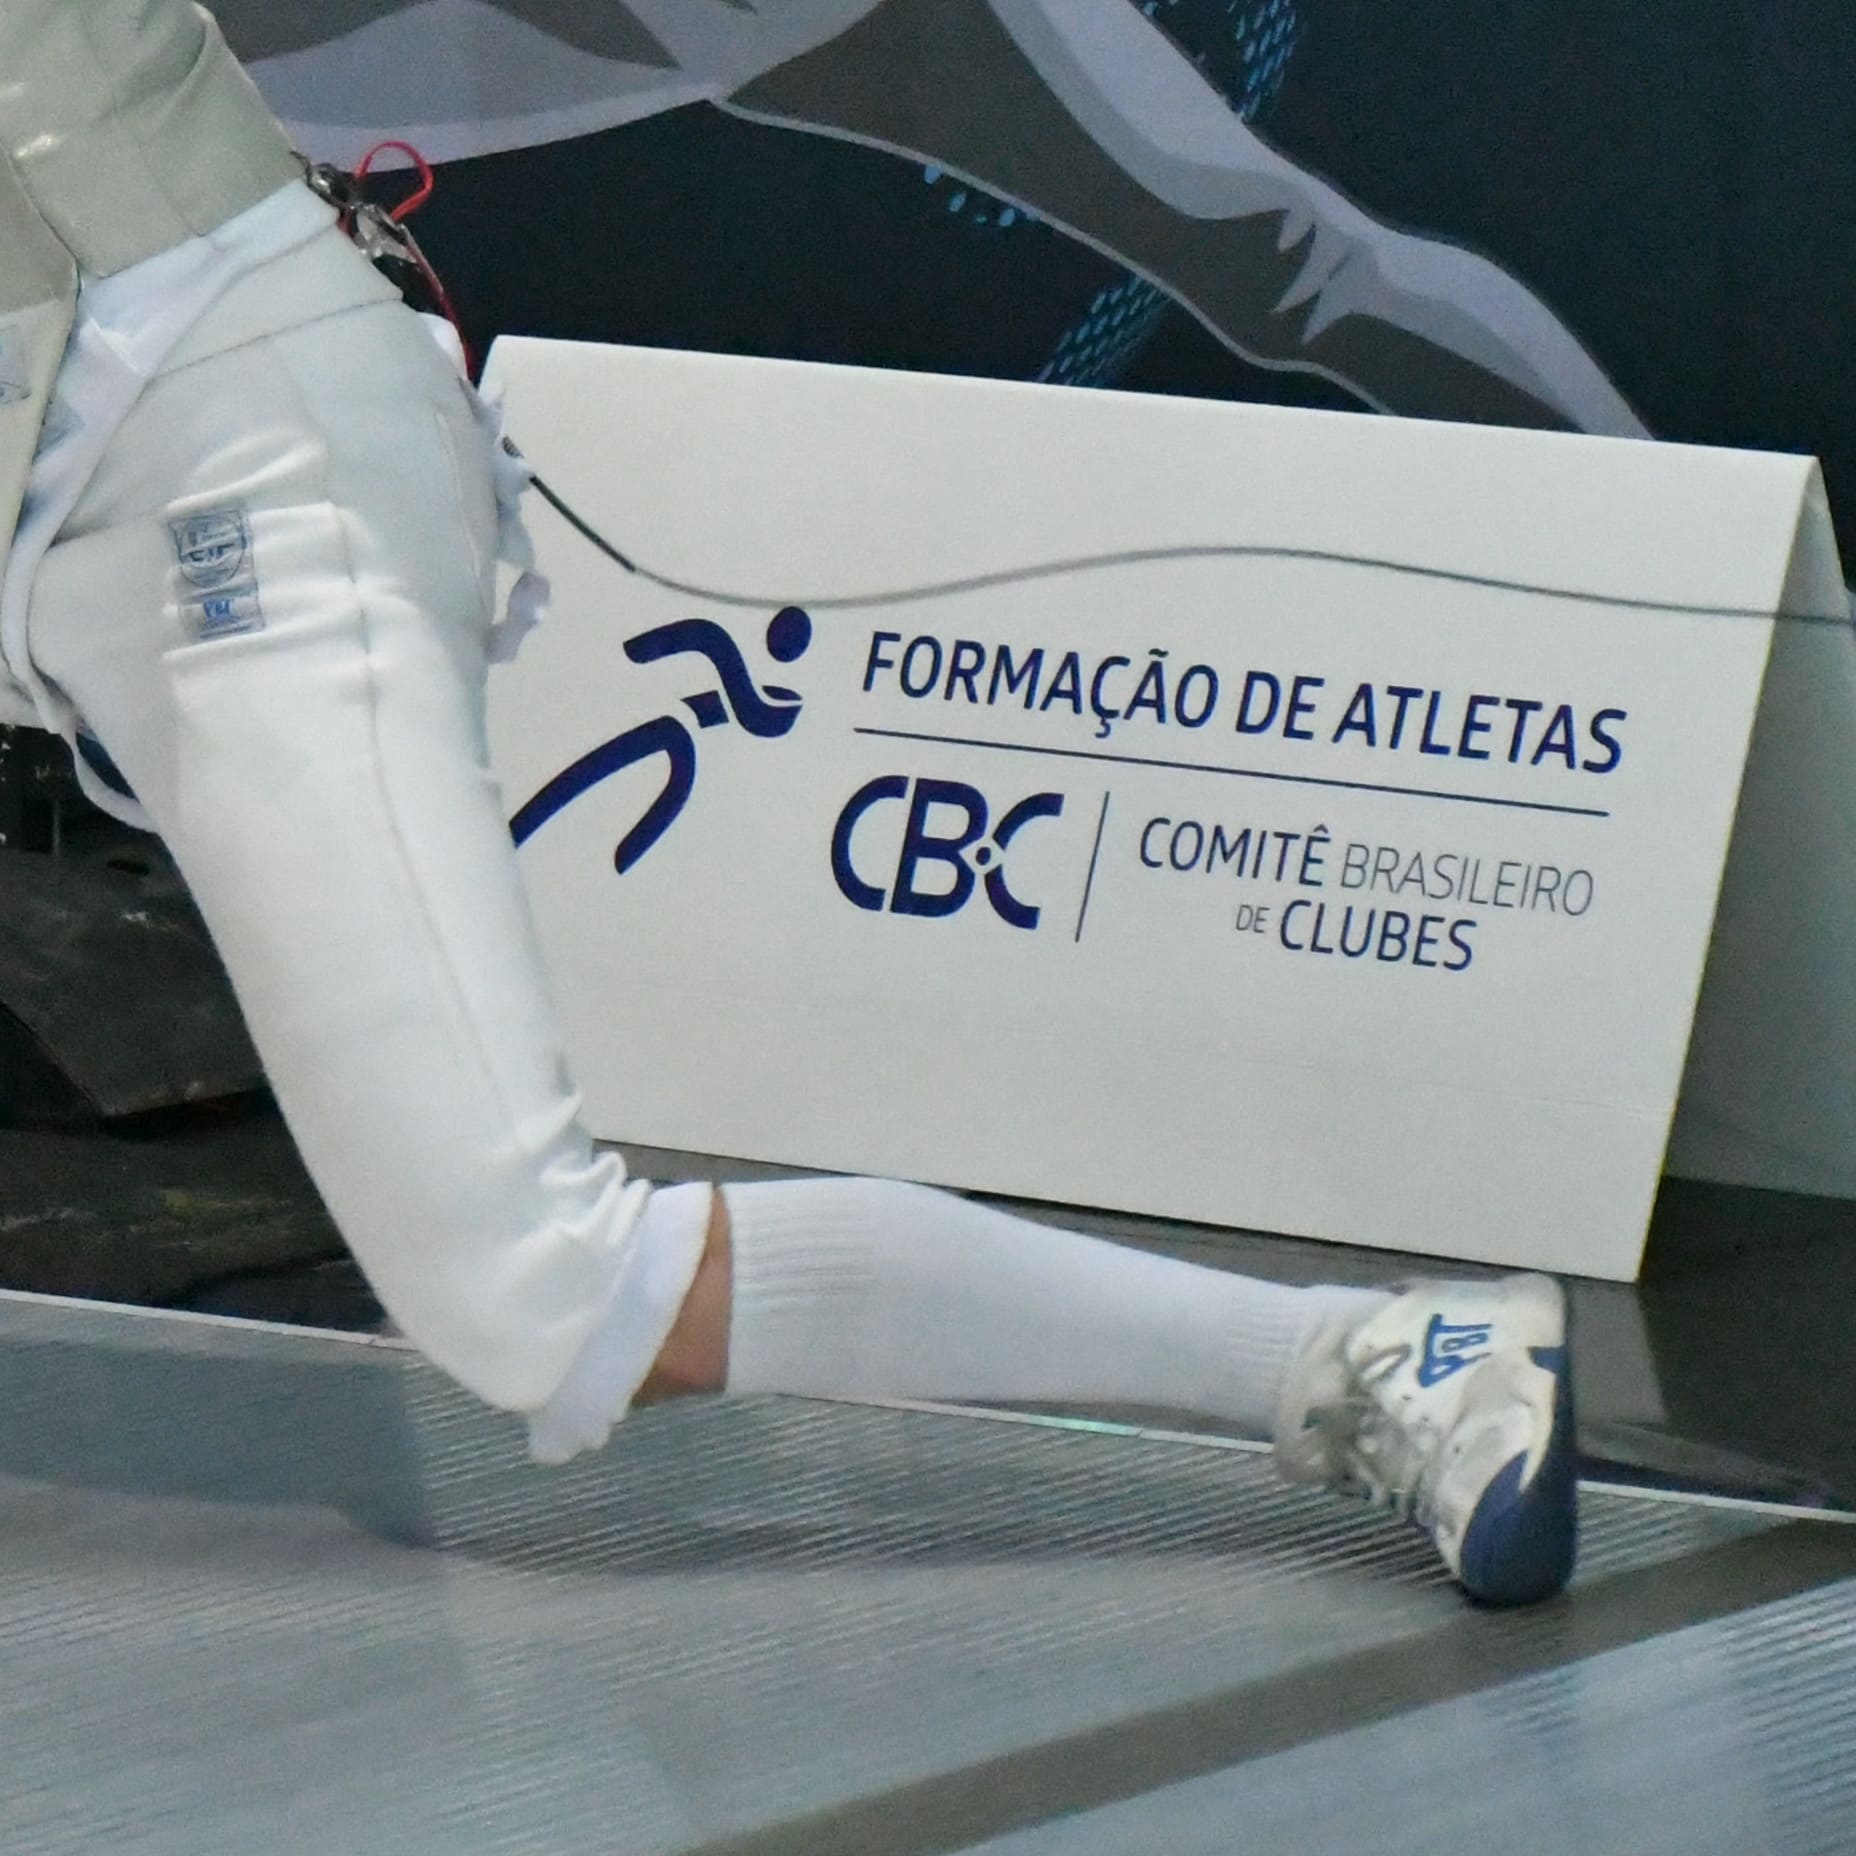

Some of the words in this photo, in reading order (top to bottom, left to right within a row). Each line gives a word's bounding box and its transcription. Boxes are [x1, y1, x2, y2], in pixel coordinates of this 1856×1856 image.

[862, 630, 1219, 738] FORMAÇÃO
[1236, 669, 1324, 740] DE
[1332, 682, 1628, 775] ATLETAS
[1138, 817, 1332, 887] COMITÊ
[1340, 843, 1594, 918] BRASILEIRO
[1236, 904, 1269, 935] DE
[1279, 899, 1476, 973] CLUBES
[1417, 1313, 1493, 1388] PBT
